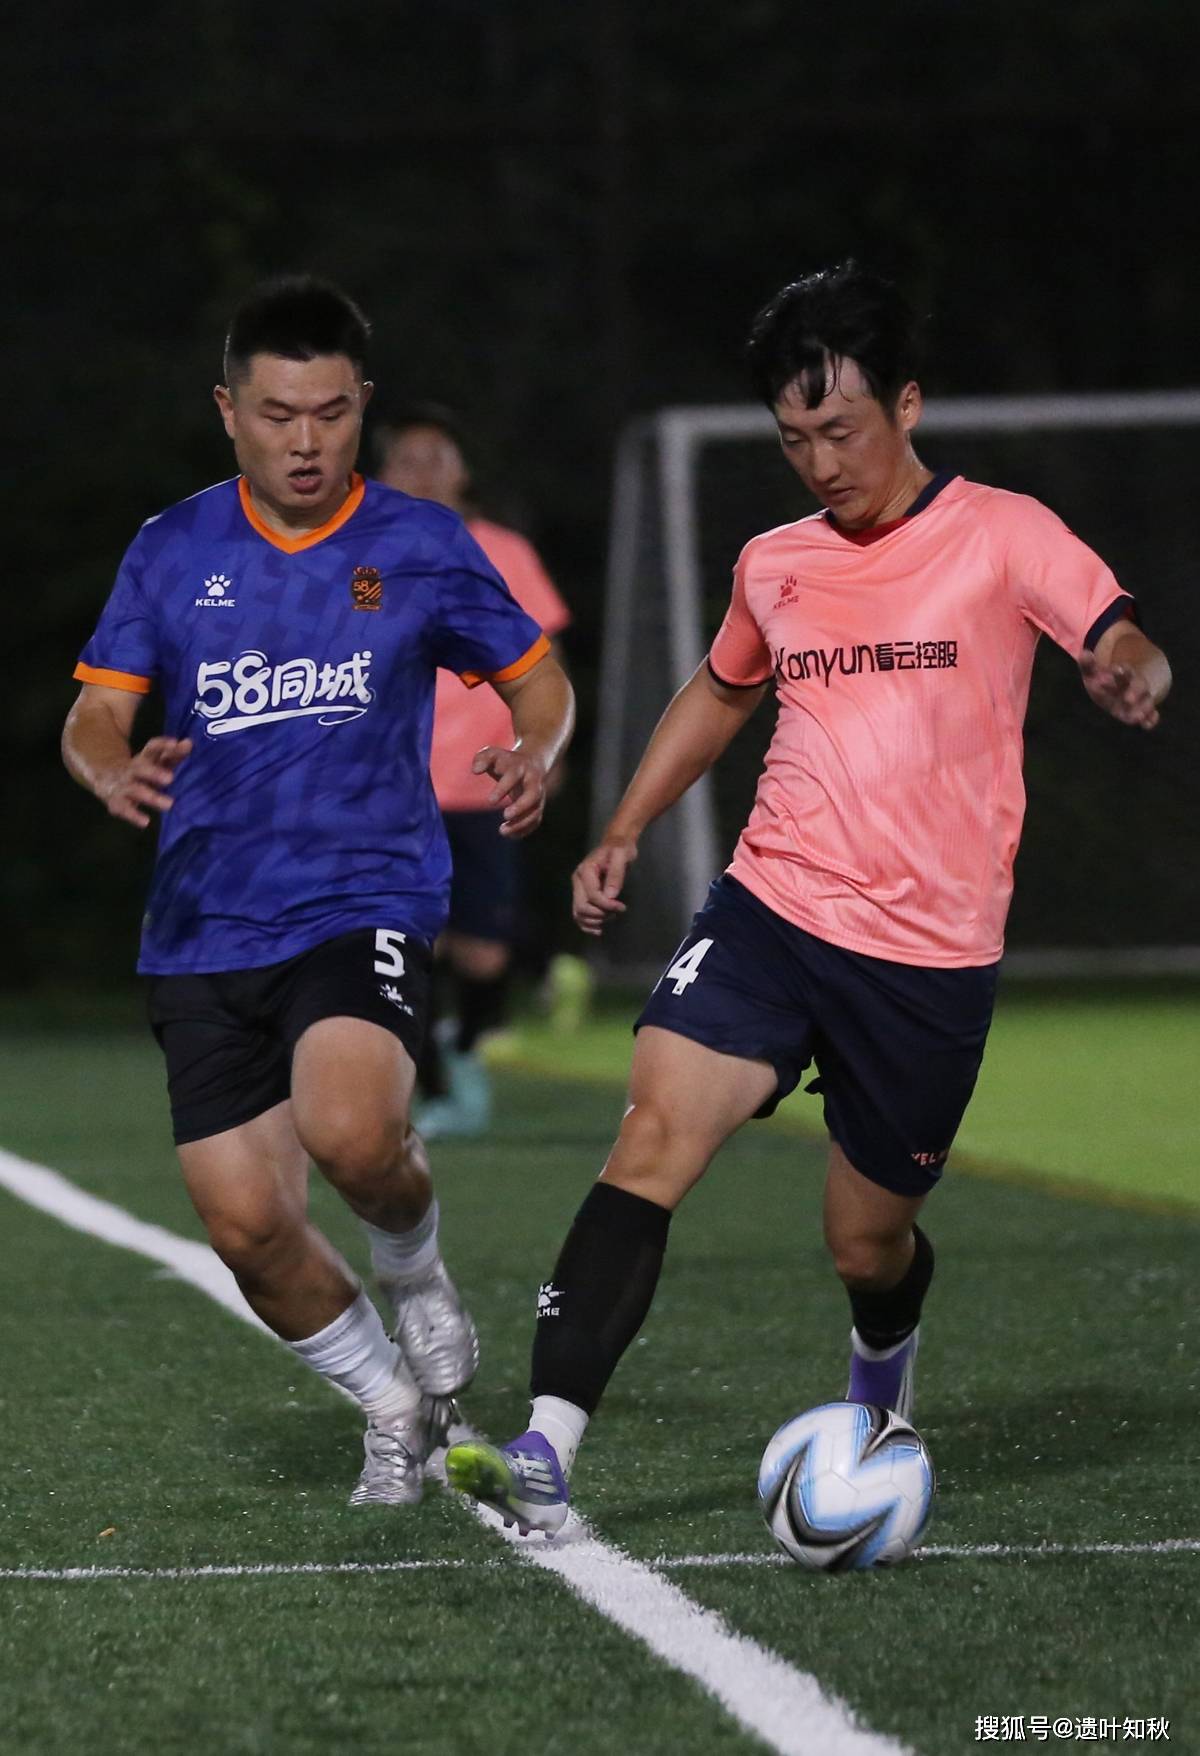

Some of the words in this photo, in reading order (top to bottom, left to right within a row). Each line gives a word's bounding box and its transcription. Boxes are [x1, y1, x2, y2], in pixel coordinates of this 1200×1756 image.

[195, 598, 236, 607] KELME
[353, 580, 370, 592] 58
[193, 650, 373, 719] 58同城
[374, 928, 407, 978] 5
[652, 935, 715, 996] 4
